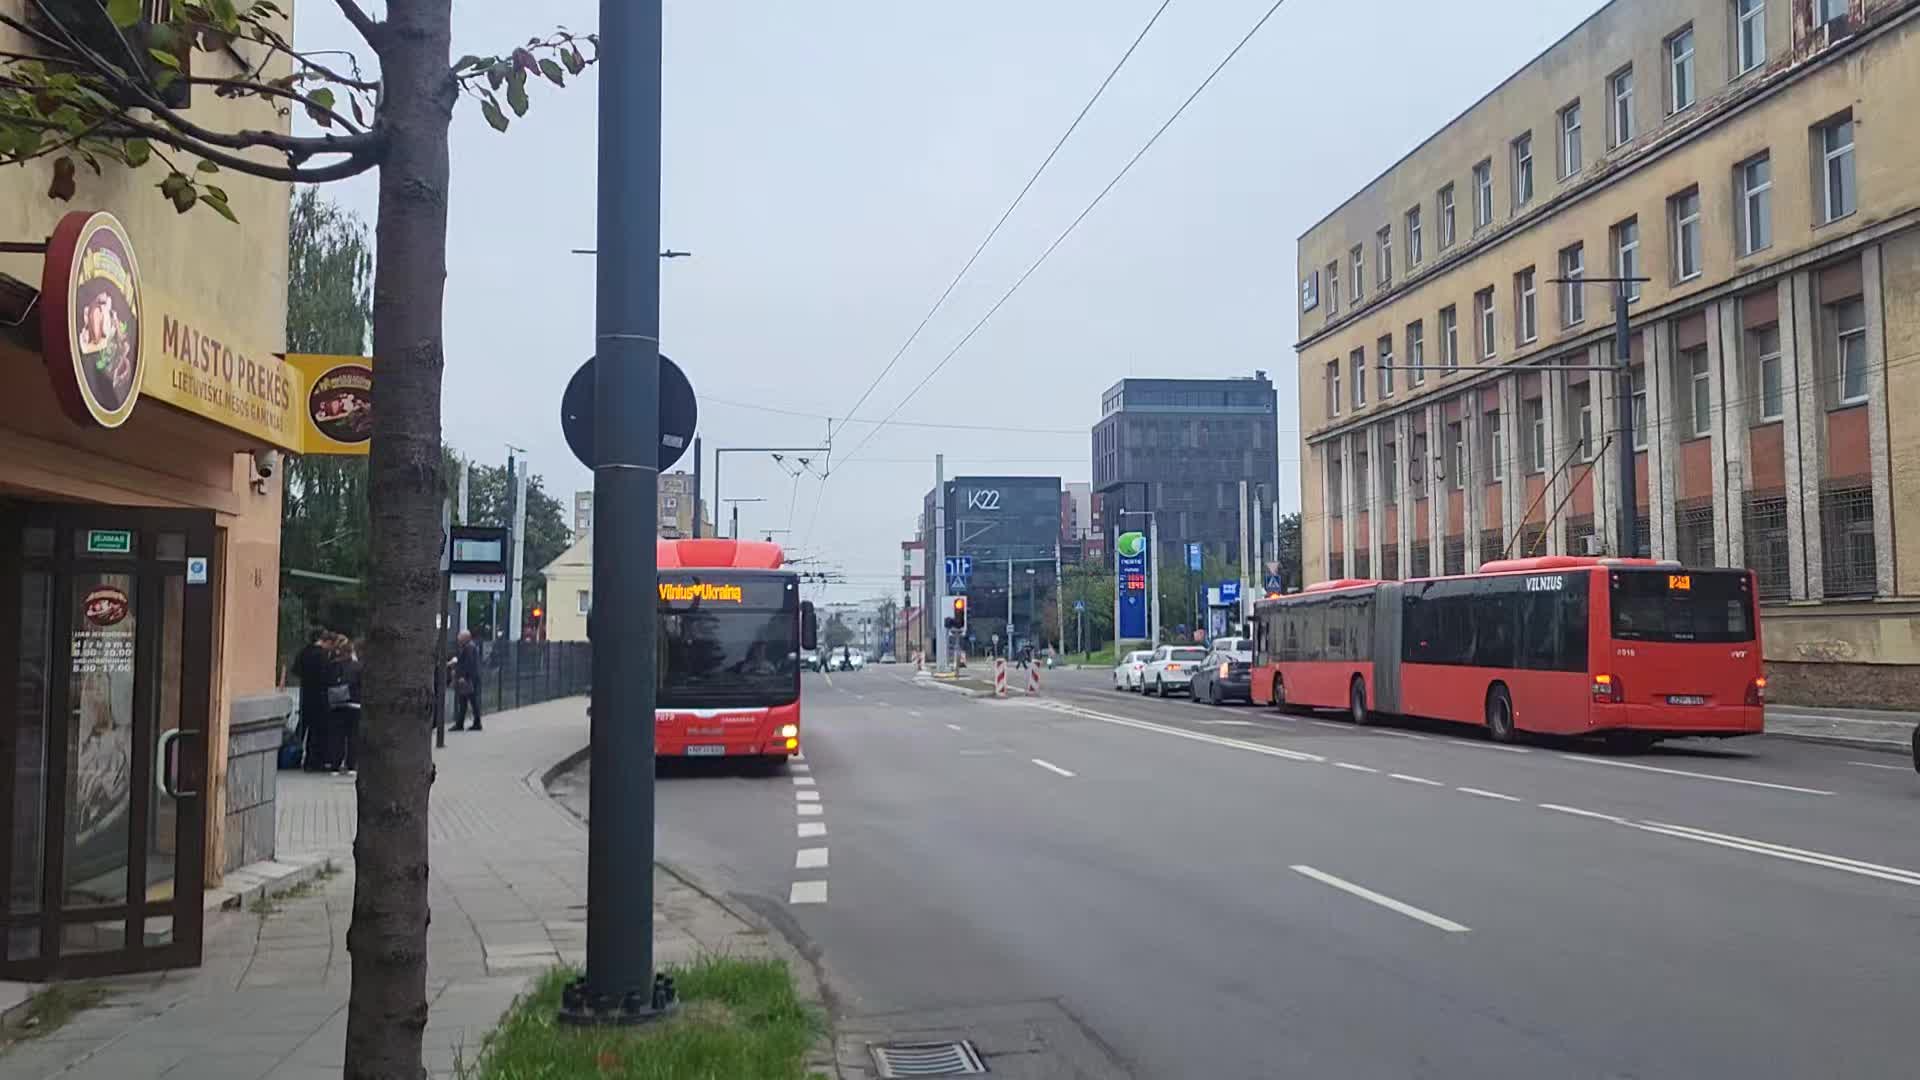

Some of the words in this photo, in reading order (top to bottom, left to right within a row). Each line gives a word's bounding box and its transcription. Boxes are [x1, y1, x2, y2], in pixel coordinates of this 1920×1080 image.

[162, 313, 234, 384] MAISTO
[237, 353, 289, 412] PREKĖS
[171, 367, 223, 408] LIETUVIŠKI
[968, 488, 1000, 510] K22
[659, 584, 693, 600] Vilnius
[1526, 575, 1562, 591] VILNIUS
